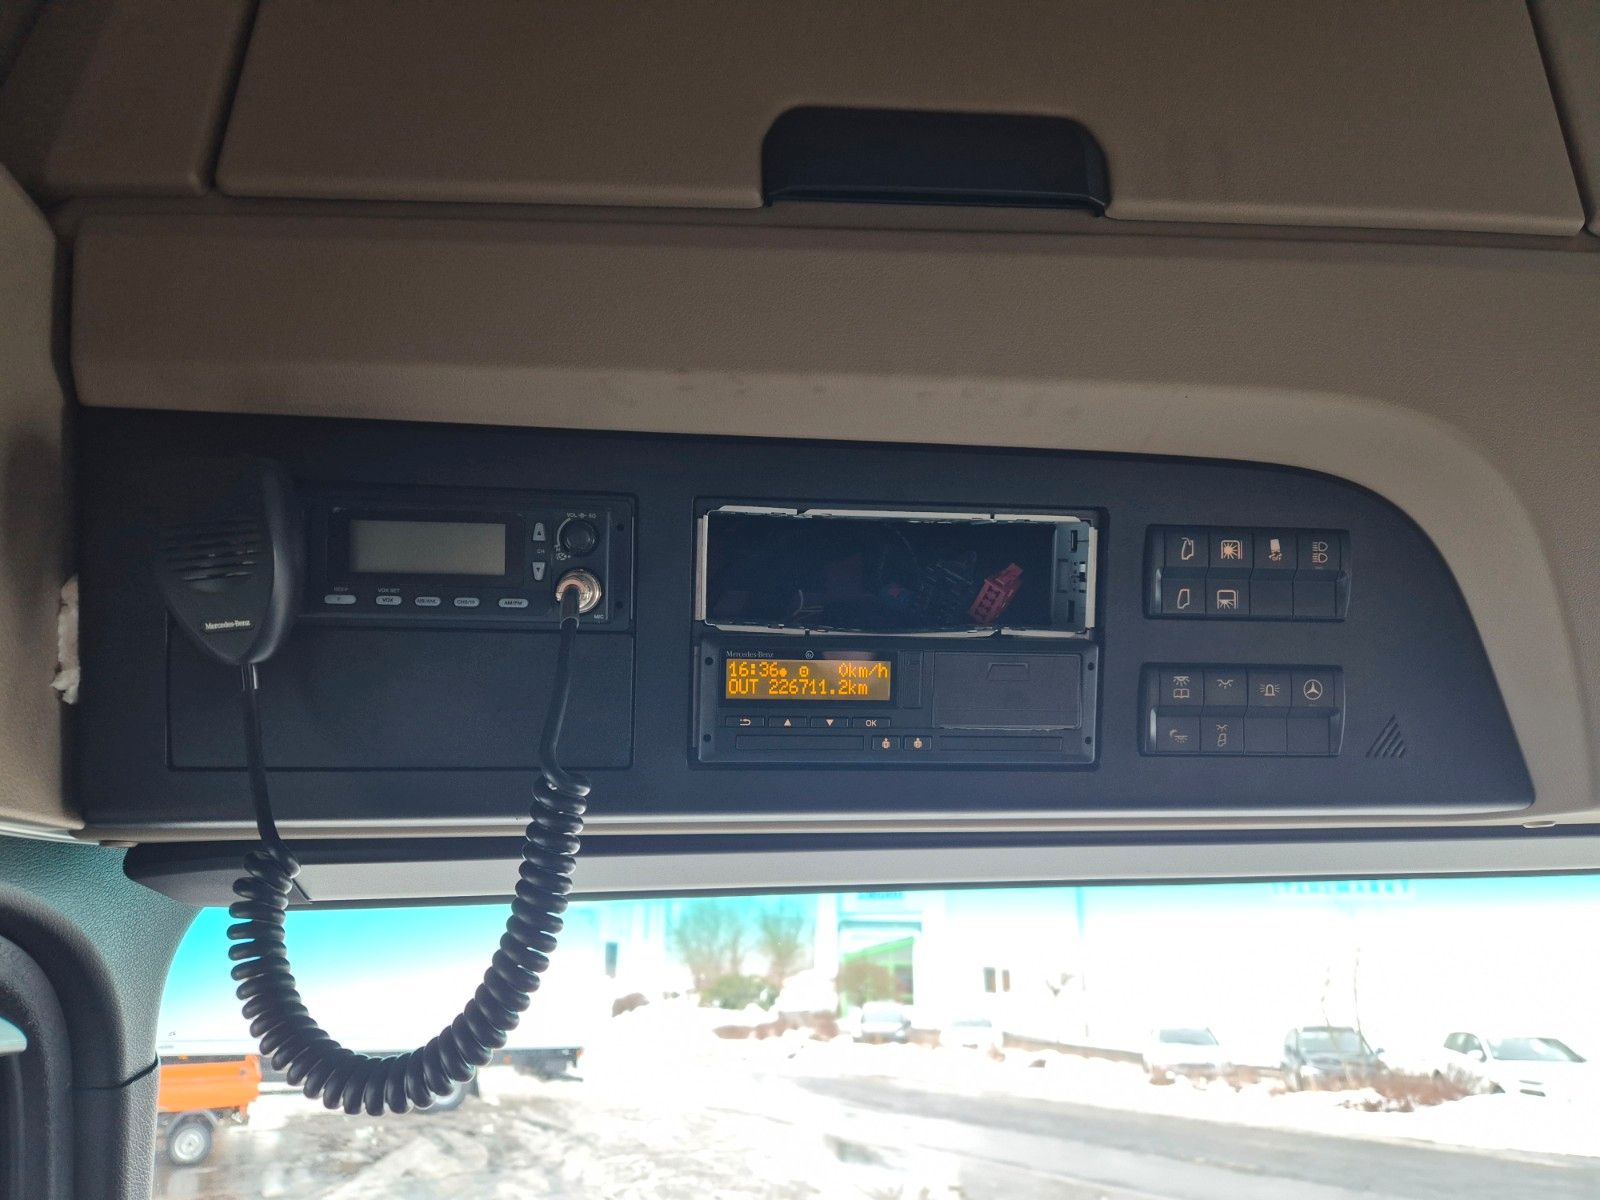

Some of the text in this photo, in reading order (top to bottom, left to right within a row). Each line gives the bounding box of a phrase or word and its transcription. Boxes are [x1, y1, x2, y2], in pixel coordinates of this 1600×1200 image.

[204, 619, 251, 630] Mercedes-Benz
[728, 678, 869, 696] OUT 226711.2km
[864, 719, 877, 727] OK
